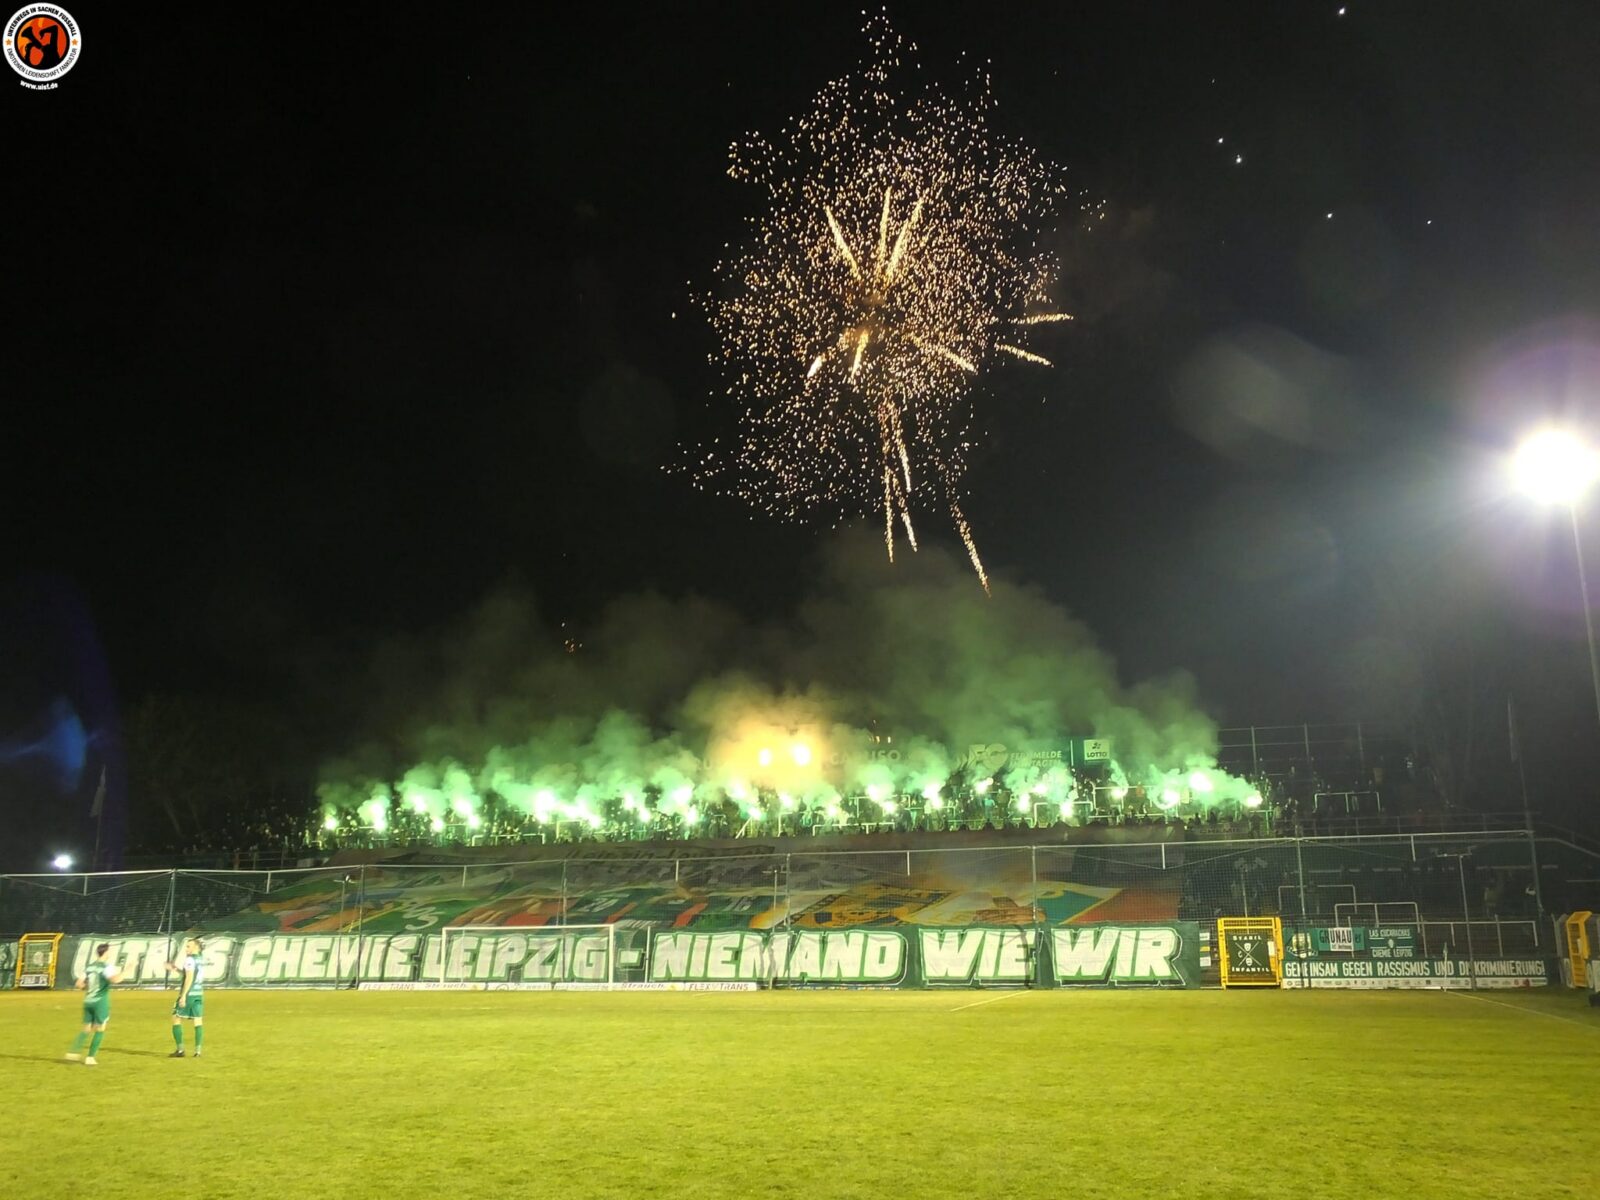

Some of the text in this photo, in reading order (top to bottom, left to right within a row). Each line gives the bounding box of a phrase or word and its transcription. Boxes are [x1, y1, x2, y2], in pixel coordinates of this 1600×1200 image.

[237, 934, 418, 979] CHEMIE
[421, 935, 610, 980] LEIPZIG
[652, 932, 903, 979] NIEMAND
[921, 929, 1036, 978] WIE
[1053, 929, 1178, 978] WIR
[1285, 960, 1546, 977] GEMEINSAM GEGEN RASSISMUS UND DIKRIMINIERUNG!
[688, 982, 749, 992] FLEX TRANS
